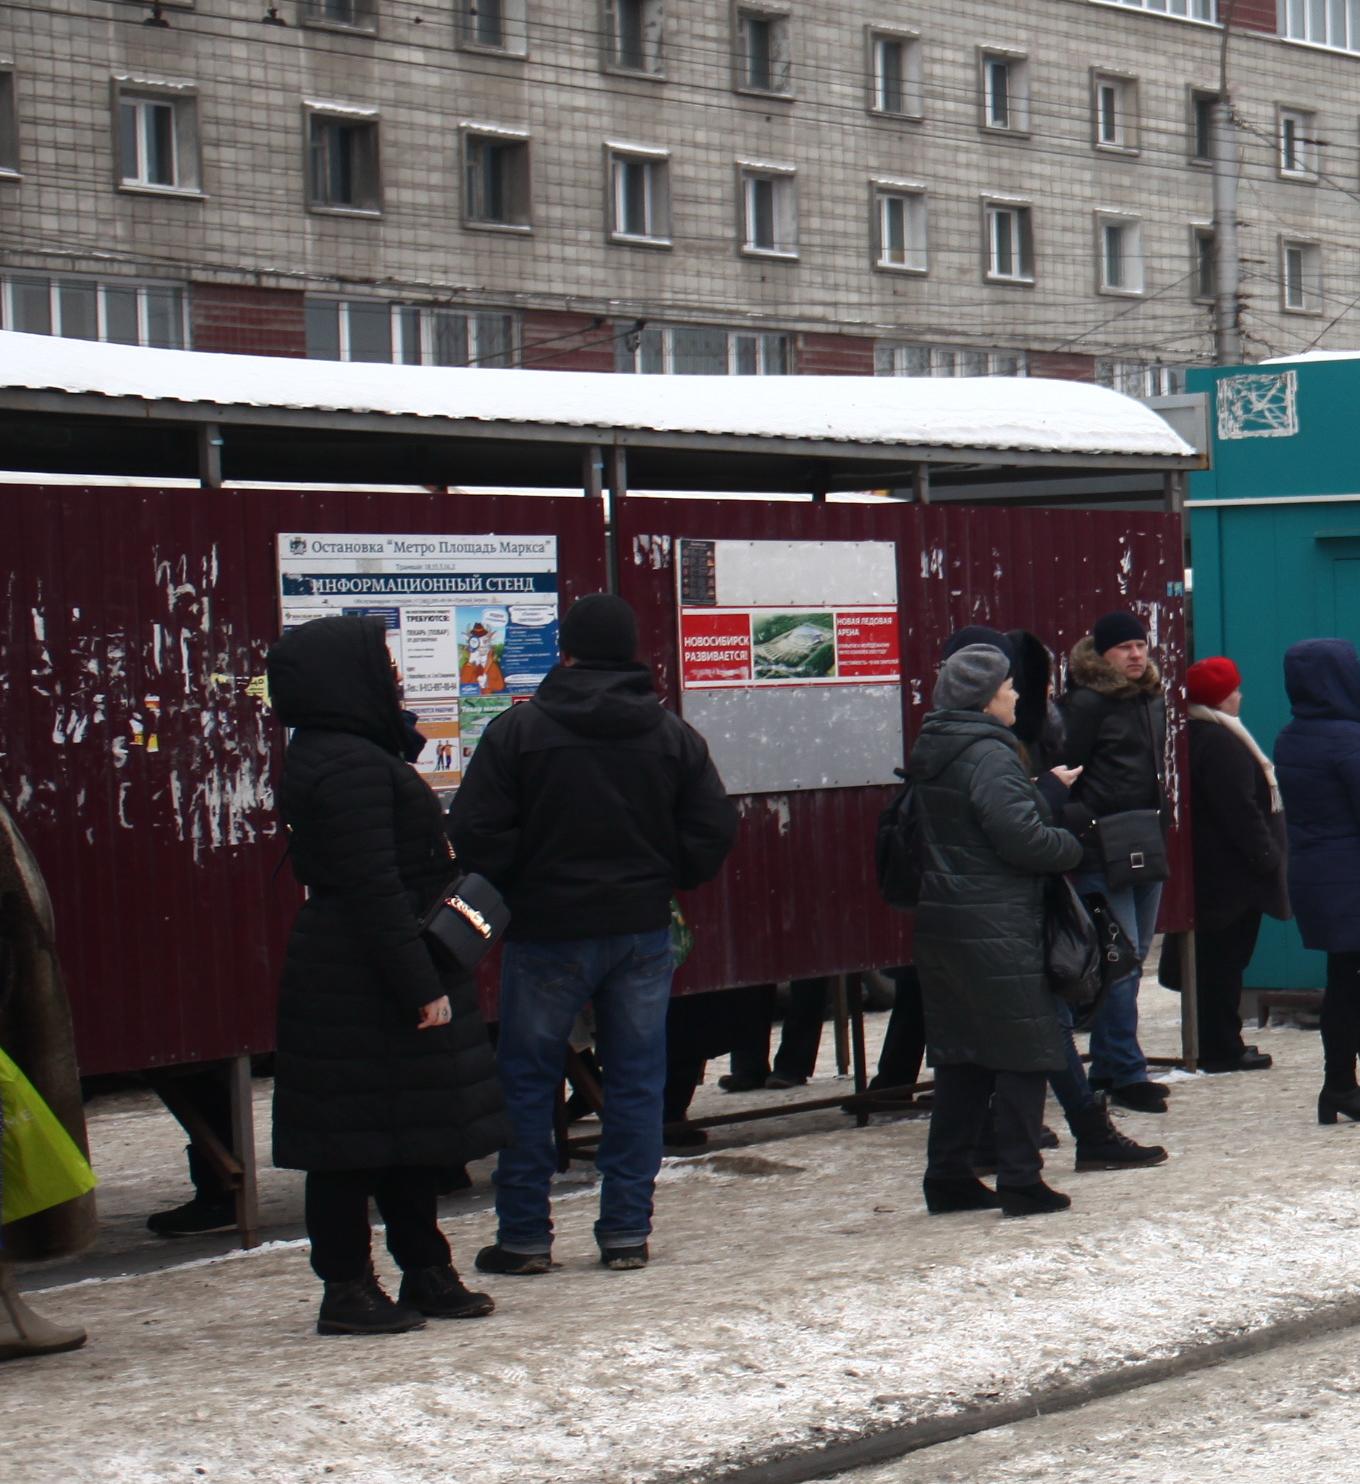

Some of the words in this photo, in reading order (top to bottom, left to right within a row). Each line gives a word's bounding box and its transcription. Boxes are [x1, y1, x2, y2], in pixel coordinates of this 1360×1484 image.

[311, 541, 384, 553] Остановка
[439, 542, 497, 556] Площадь
[486, 577, 535, 592] СТЕНД
[684, 636, 750, 648] НОВОСИБИРСК
[684, 651, 748, 663] РАЗВИВАЕТСЯ!
